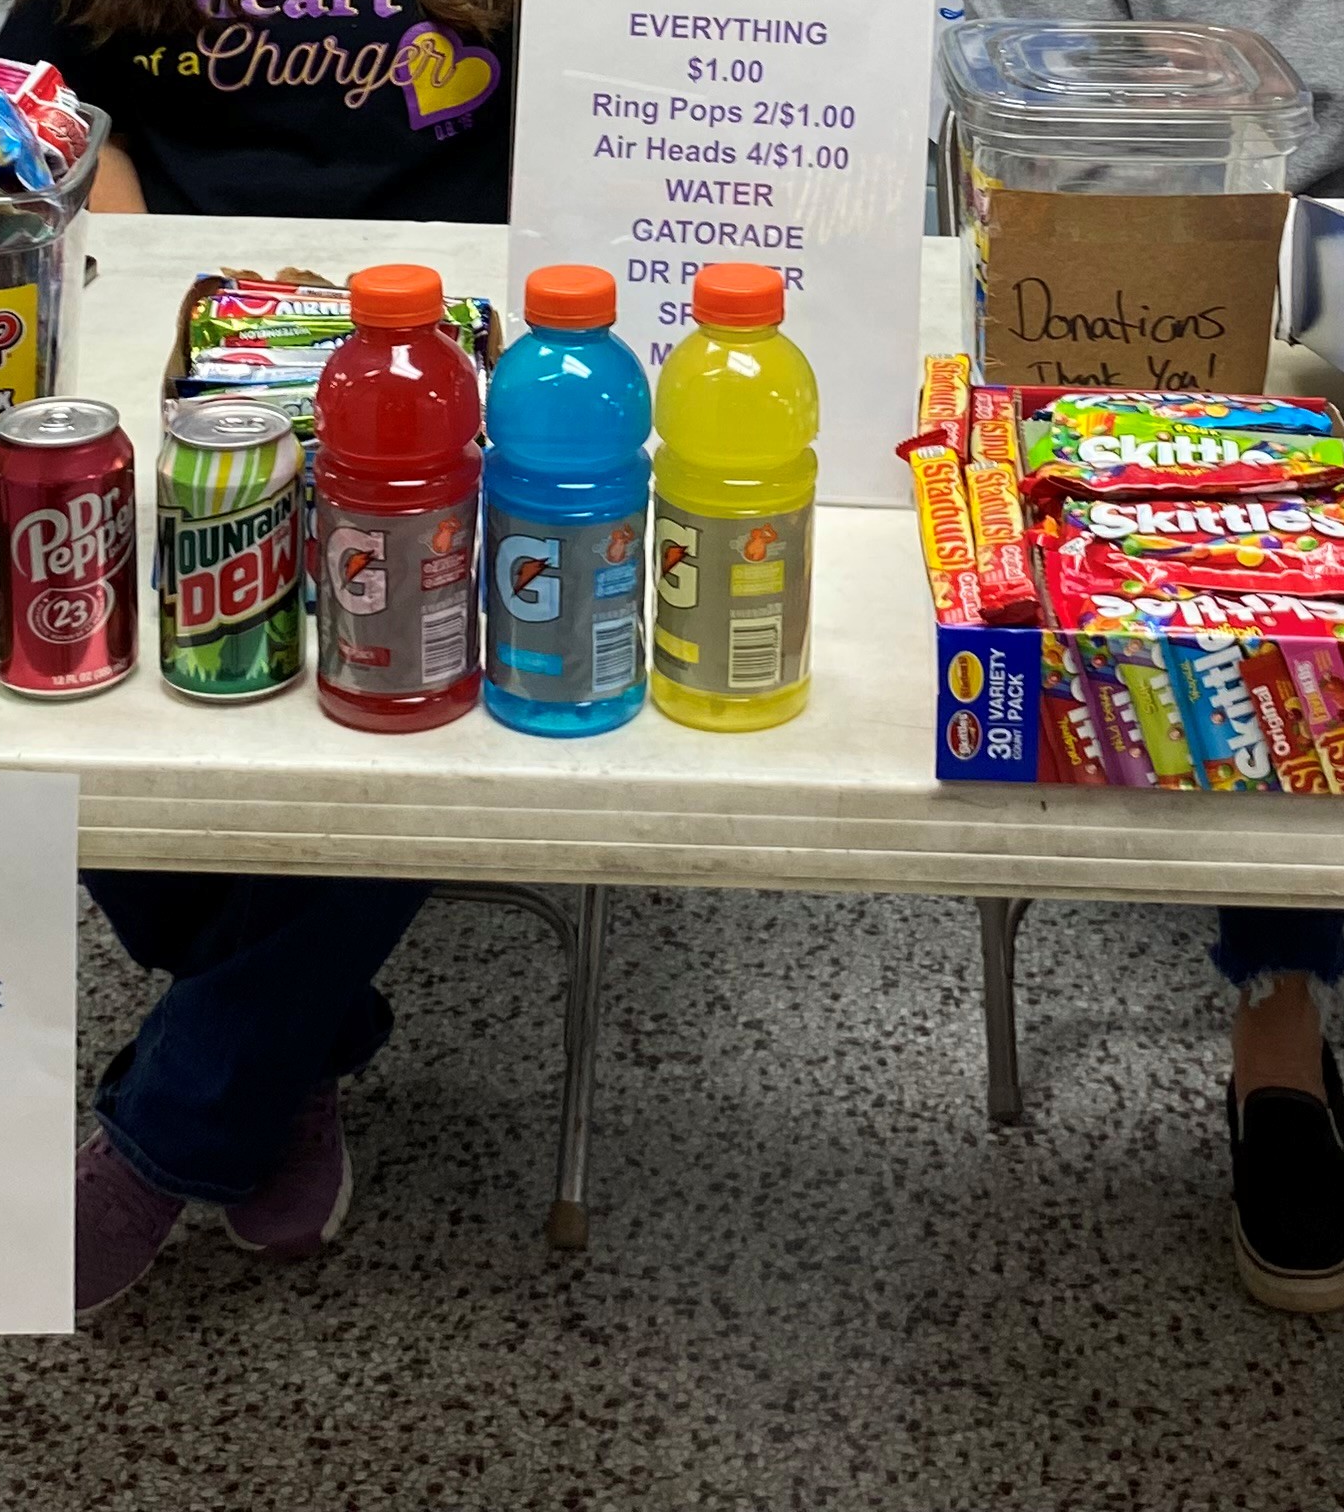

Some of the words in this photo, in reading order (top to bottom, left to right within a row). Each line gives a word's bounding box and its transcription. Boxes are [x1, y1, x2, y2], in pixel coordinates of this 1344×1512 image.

[629, 12, 829, 46] EVERYTHING
[177, 50, 201, 77] a
[197, 22, 458, 110] Charger
[687, 56, 764, 84] $1.00
[592, 93, 659, 125] Ring
[669, 96, 743, 128] Pops
[752, 101, 856, 130] 2/$1.00
[593, 134, 638, 162] Air
[646, 136, 736, 166] Heads
[746, 142, 849, 170] 4/$1.00
[664, 178, 773, 207] WATER
[631, 218, 805, 249] GATORADE
[627, 259, 670, 285] DR
[1009, 275, 1227, 343] Donations
[1027, 361, 1121, 387] Thank
[1147, 352, 1217, 390] You!
[68, 487, 121, 539] Dr
[327, 525, 388, 615] G
[495, 534, 561, 622] G
[53, 598, 89, 629] 23
[988, 648, 1006, 722] VARIETY
[1006, 673, 1025, 723] PACK
[988, 727, 1012, 760] 30
